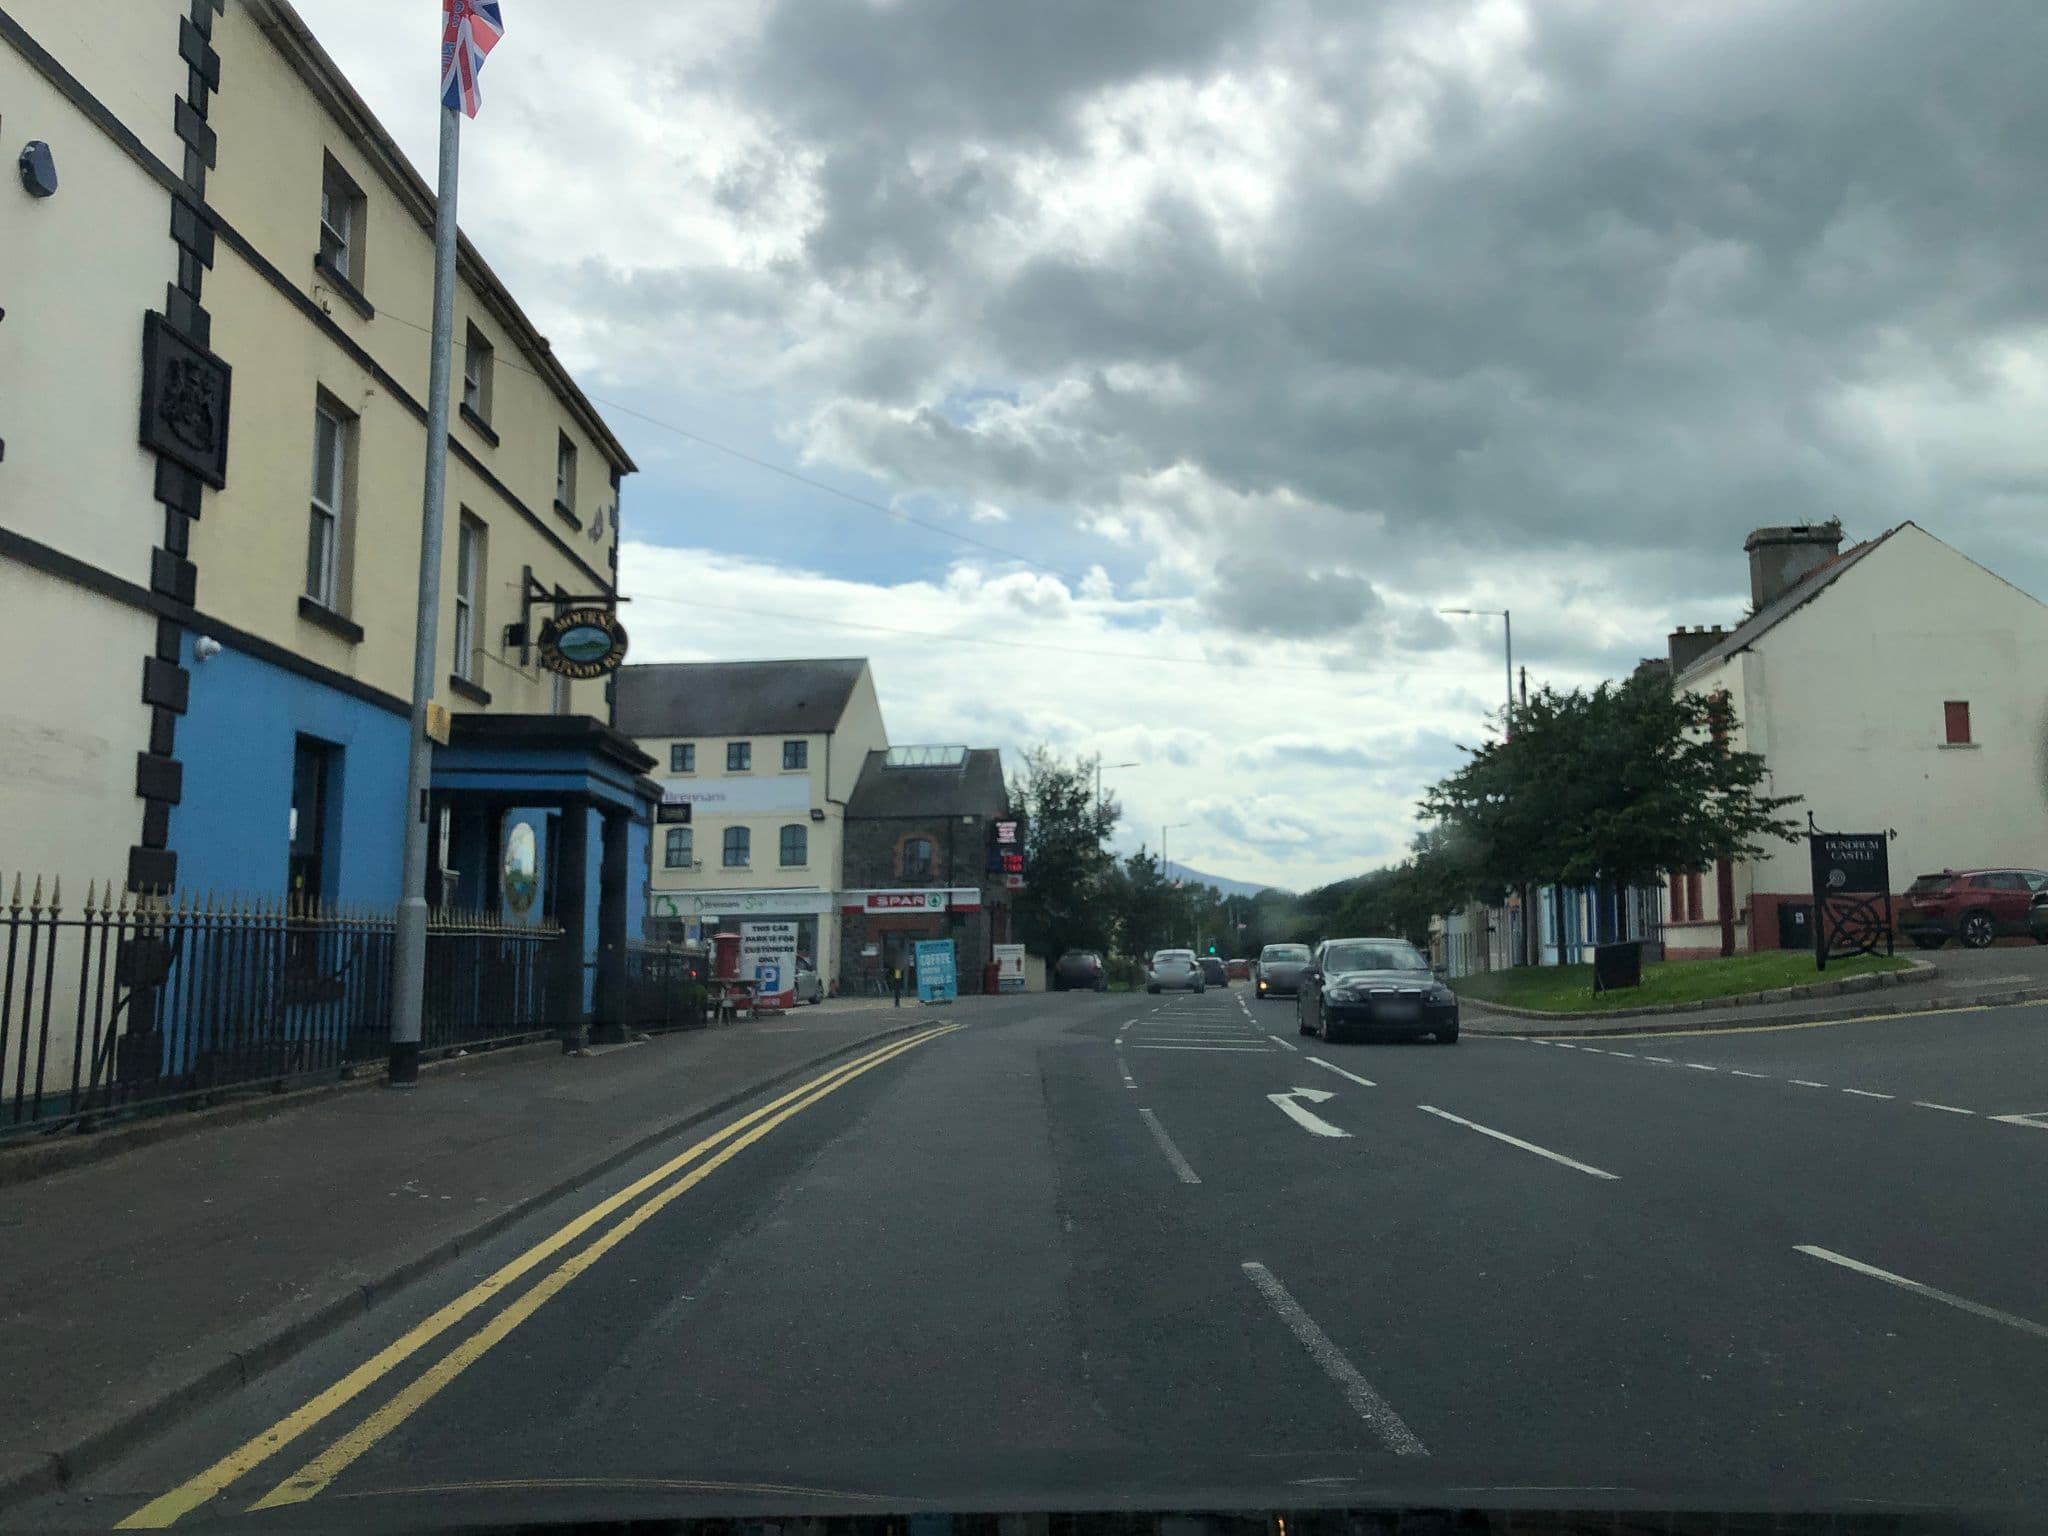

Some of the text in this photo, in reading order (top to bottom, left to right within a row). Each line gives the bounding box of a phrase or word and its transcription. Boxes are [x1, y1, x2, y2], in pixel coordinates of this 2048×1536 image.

[1825, 840, 1880, 850] DUNDRUM
[1831, 851, 1874, 861] CASTLE
[876, 895, 925, 907] SPAR
[744, 946, 795, 954] CUSTOMERS
